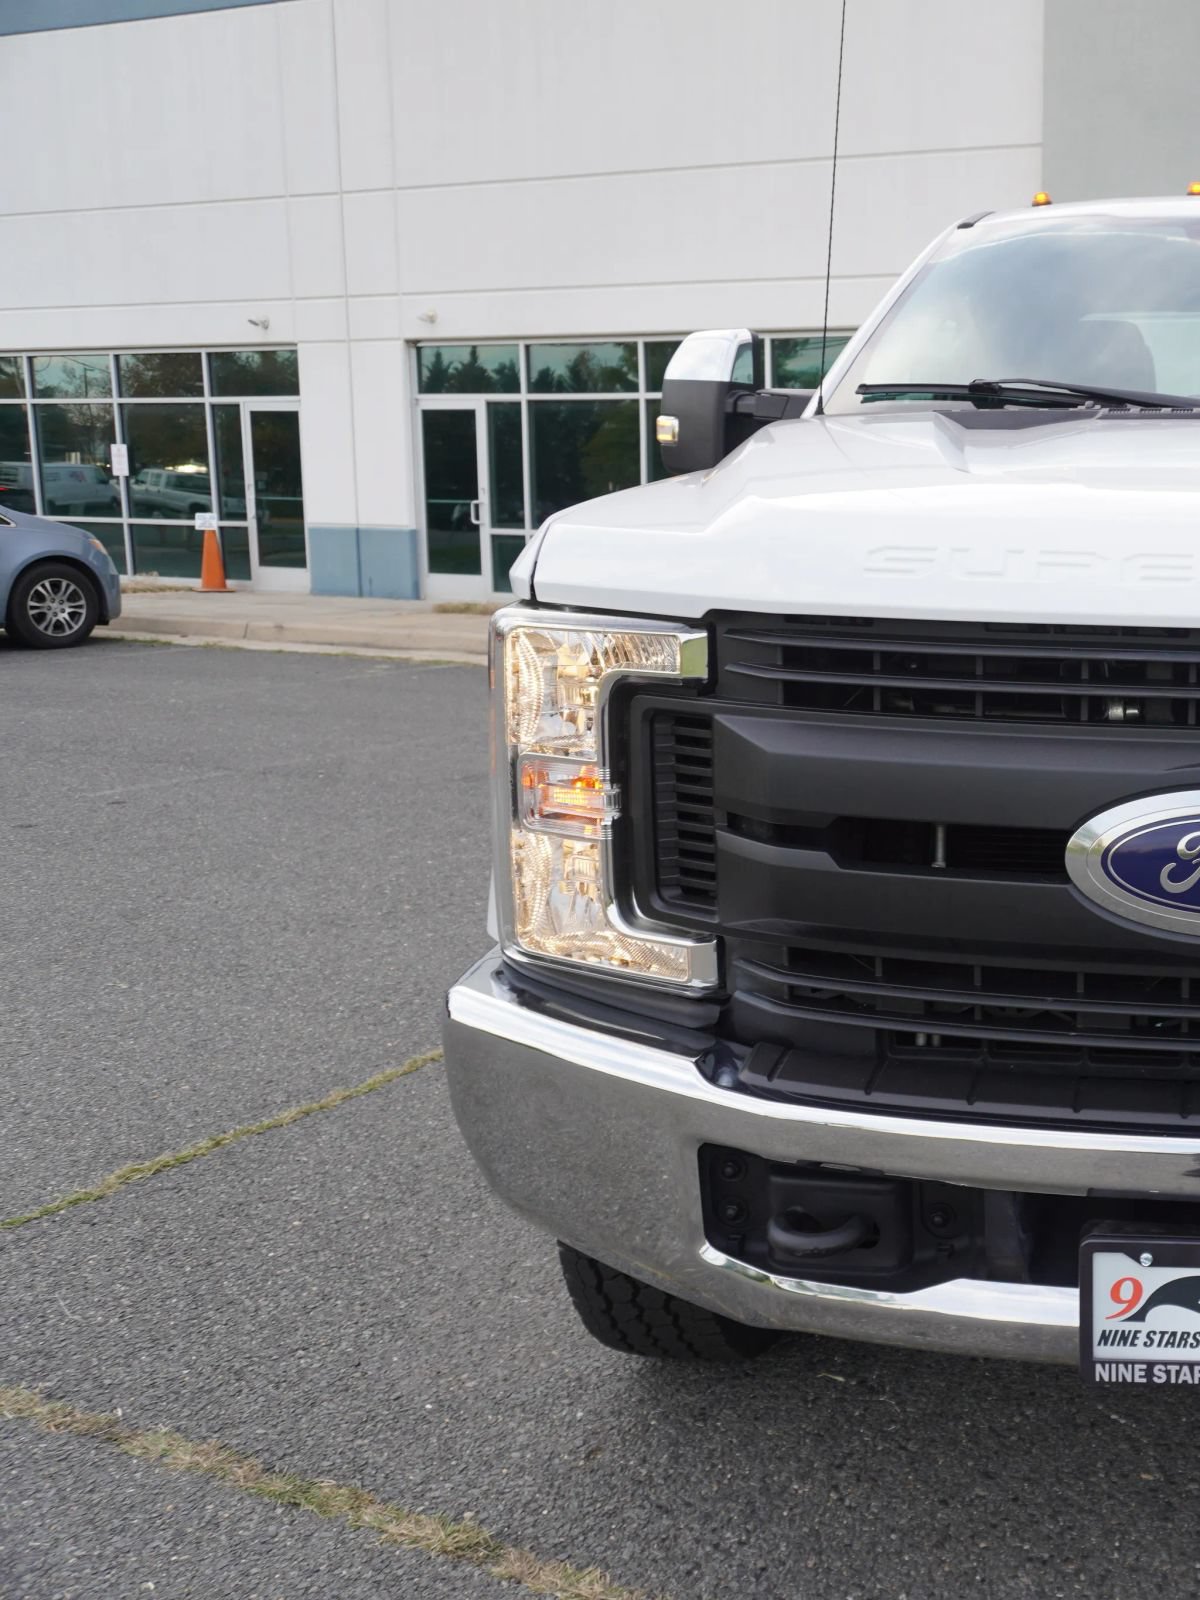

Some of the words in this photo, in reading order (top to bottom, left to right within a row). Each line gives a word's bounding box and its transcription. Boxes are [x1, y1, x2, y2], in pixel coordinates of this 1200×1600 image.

[1105, 1276, 1144, 1320] 9
[1097, 1329, 1142, 1347] NINE
[1095, 1363, 1147, 1383] NINE
